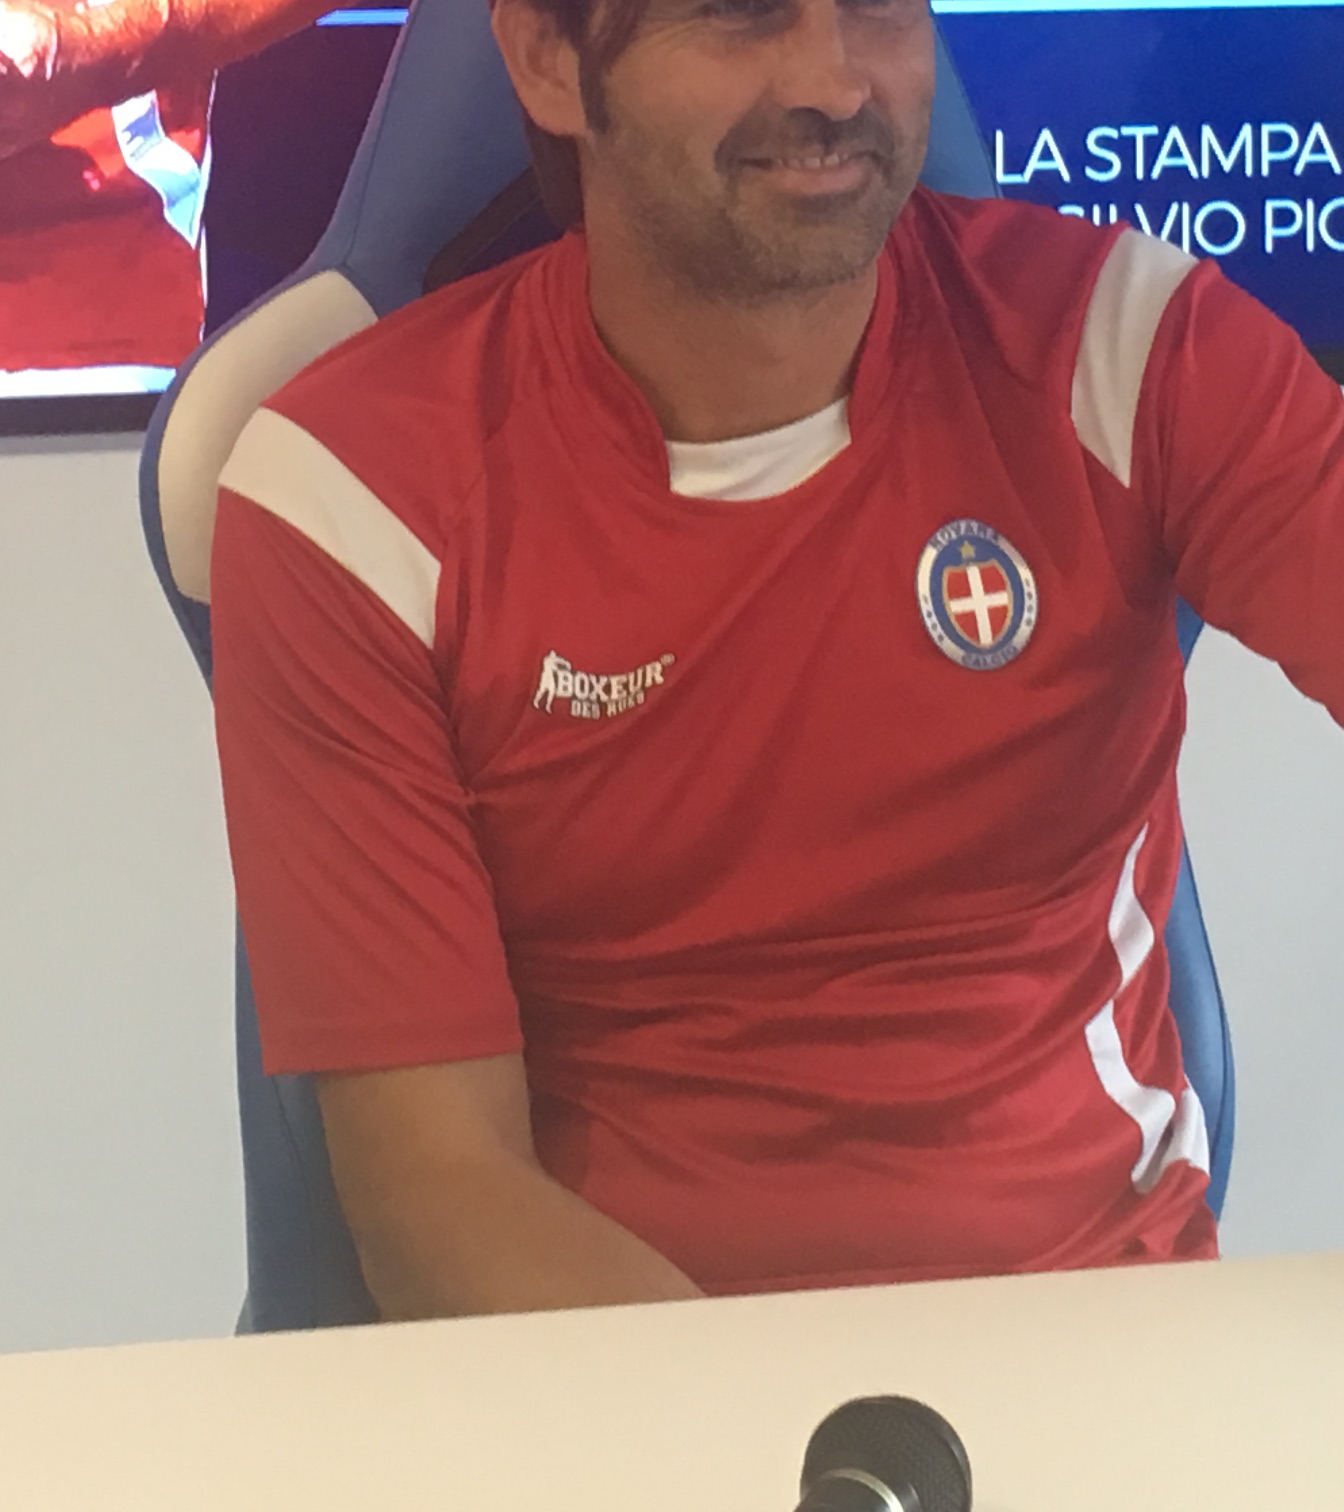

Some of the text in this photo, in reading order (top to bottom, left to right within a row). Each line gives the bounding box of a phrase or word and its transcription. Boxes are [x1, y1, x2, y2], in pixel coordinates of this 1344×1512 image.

[1084, 121, 1343, 182] STAMPA
[1057, 200, 1246, 256] VIO
[556, 660, 664, 702] BOXEUR
